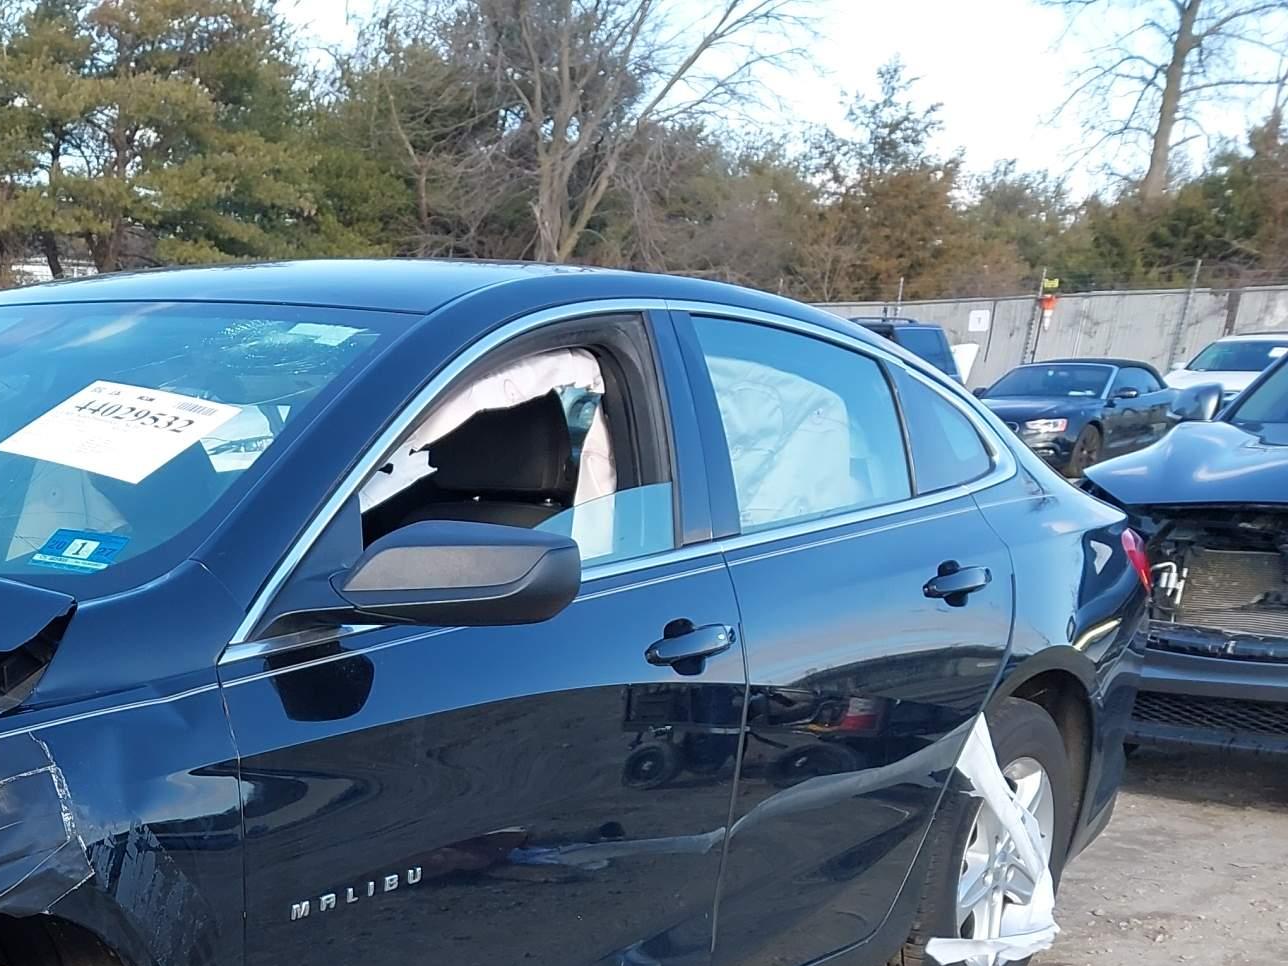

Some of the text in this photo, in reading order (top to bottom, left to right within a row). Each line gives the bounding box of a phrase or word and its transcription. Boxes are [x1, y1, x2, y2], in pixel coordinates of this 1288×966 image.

[74, 399, 195, 434] 44029532
[71, 541, 88, 556] 1
[290, 867, 422, 921] MALIBU
